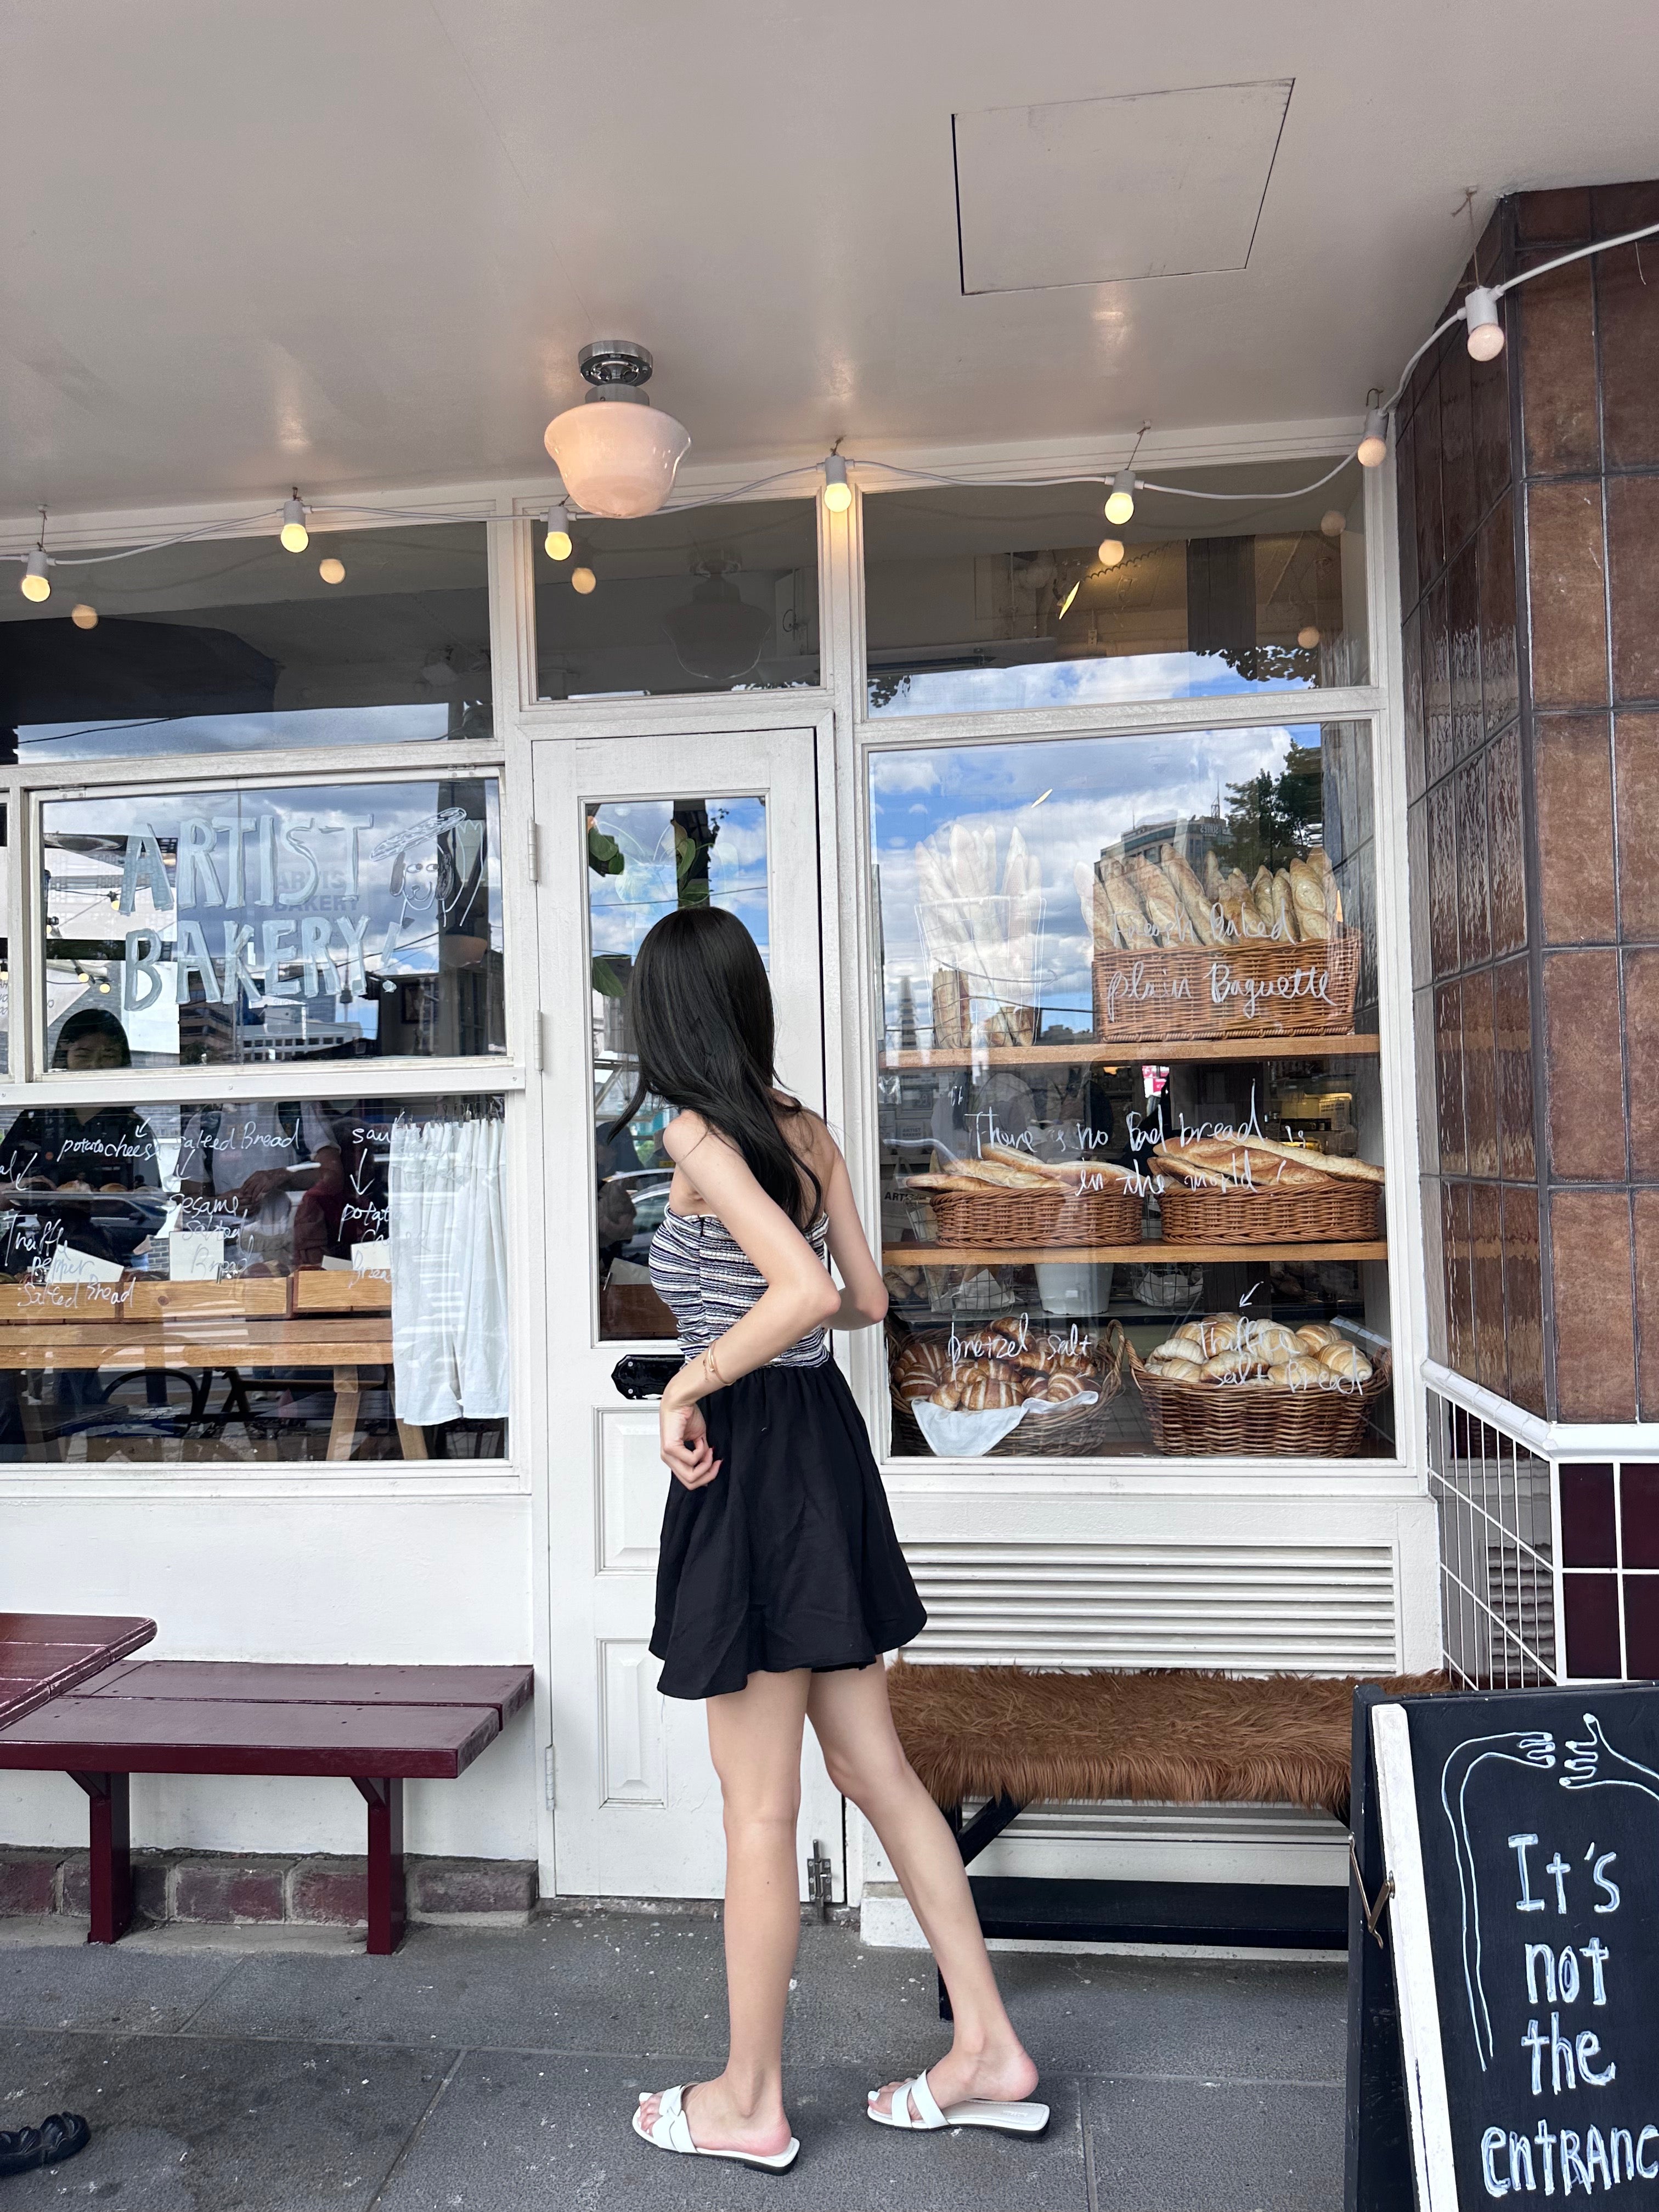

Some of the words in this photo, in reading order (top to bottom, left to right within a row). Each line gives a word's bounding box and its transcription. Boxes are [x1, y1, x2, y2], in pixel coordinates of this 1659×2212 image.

[119, 814, 374, 916] ARTIST
[1210, 899, 1297, 945] Baked
[1203, 963, 1338, 1019] Baguette
[241, 1118, 300, 1150] Bread
[1508, 1833, 1621, 1915] It's
[1524, 1937, 1610, 2006] not
[1521, 2011, 1617, 2096] the
